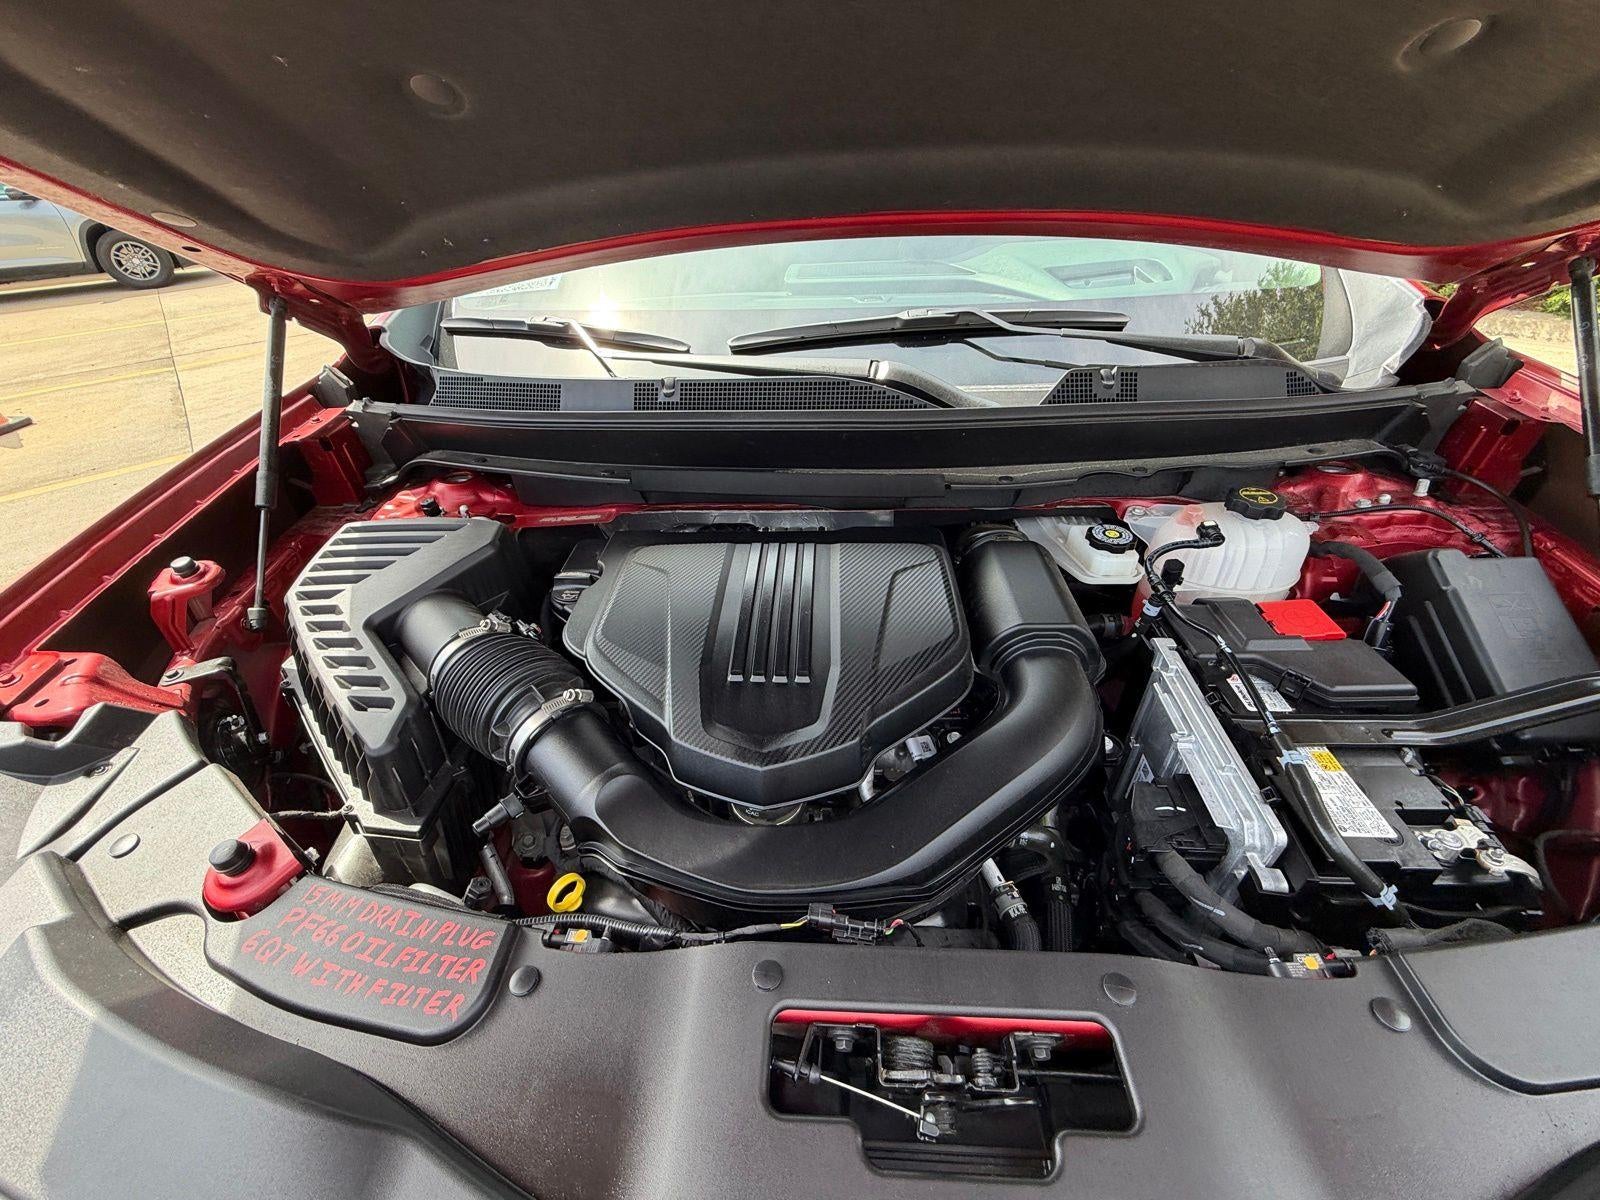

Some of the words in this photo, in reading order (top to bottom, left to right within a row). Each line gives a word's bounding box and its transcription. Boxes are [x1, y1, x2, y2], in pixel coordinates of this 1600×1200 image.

[276, 907, 349, 947] PF66
[340, 931, 396, 968] OIL
[388, 946, 487, 984] FILTER
[358, 901, 438, 939] DRAIN
[430, 920, 496, 951] PLUG
[241, 929, 298, 966] 6QT
[291, 951, 369, 997] WITH
[363, 978, 465, 1021] FILTER
